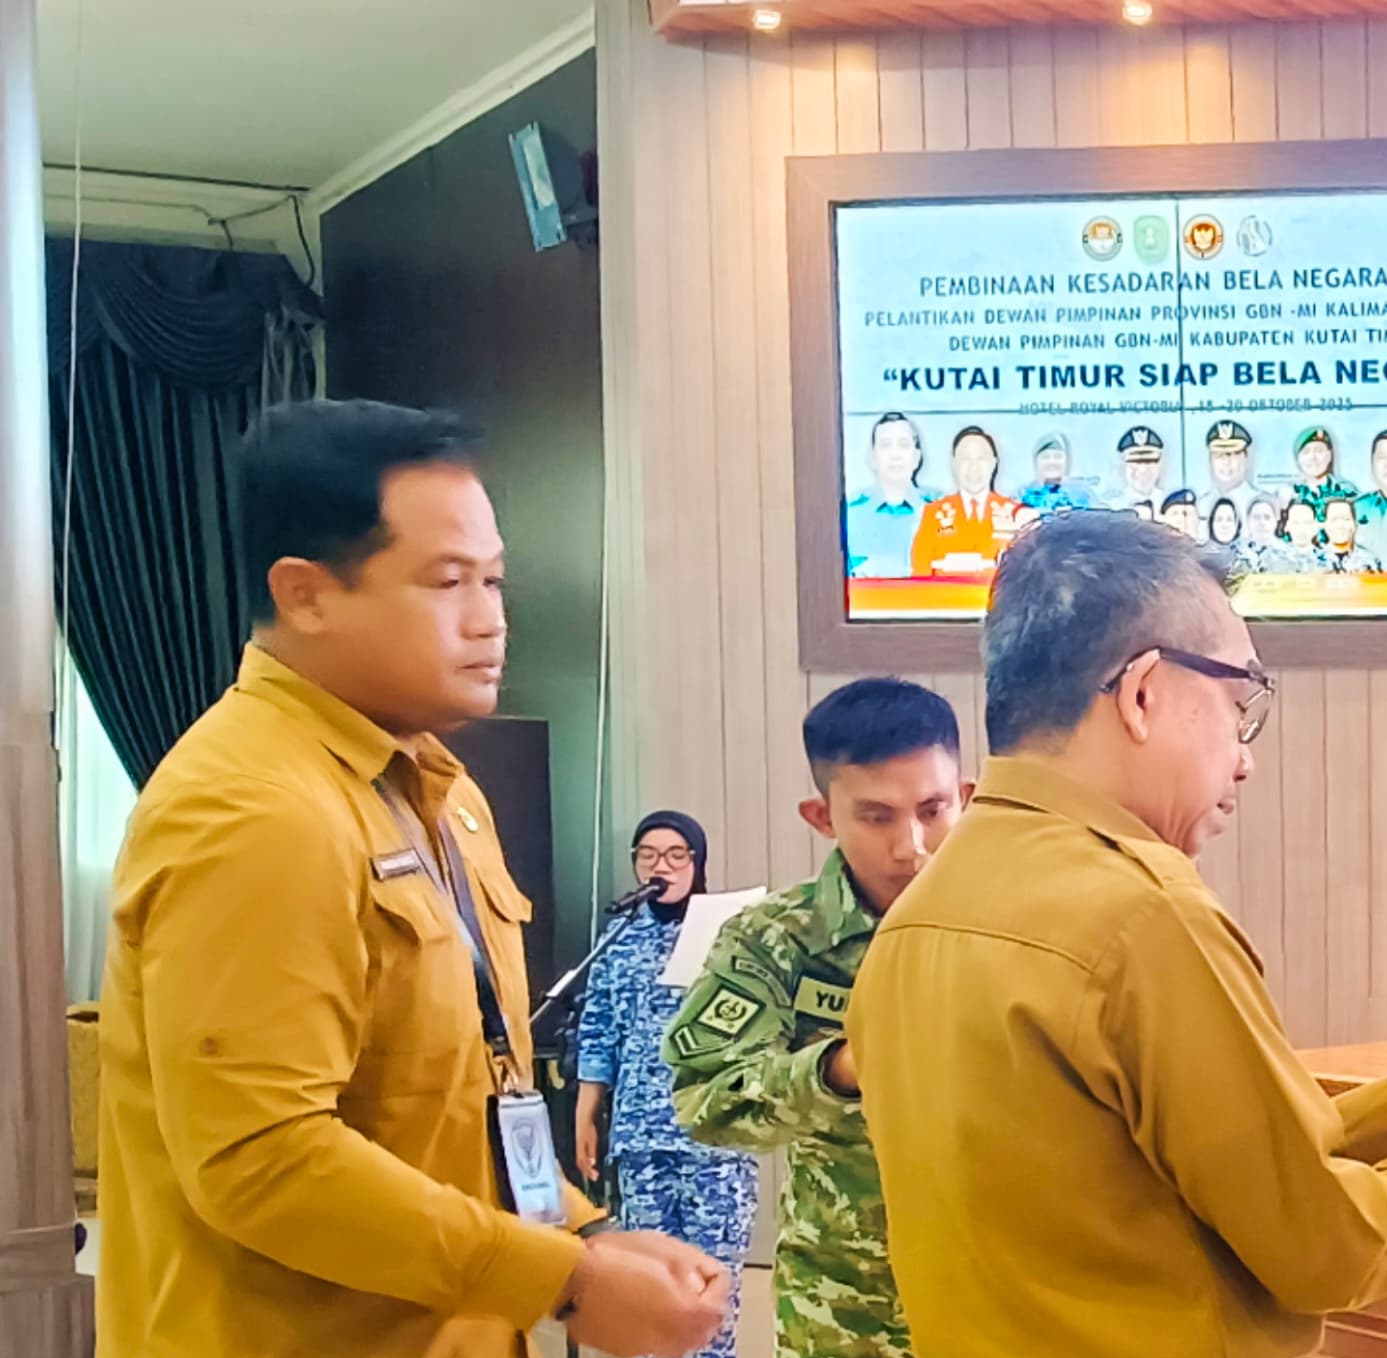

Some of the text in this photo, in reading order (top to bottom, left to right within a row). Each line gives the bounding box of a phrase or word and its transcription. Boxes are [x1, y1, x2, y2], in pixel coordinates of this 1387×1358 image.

[920, 274, 1055, 297] PEMBINAAN
[1068, 271, 1211, 294] KESADARAN
[1224, 269, 1283, 290] BELA
[865, 309, 975, 327] PELANTIKAN
[985, 308, 1047, 325] DEWAN
[1056, 306, 1141, 323] PIMPINAN
[1151, 303, 1236, 321] PROVINSI
[1246, 302, 1282, 319] GBN
[949, 334, 1010, 351] DEWAN
[1020, 333, 1105, 350] PIMPINAN
[1190, 330, 1294, 346] KABUPATEN
[1305, 329, 1357, 345] KUTAI
[1016, 364, 1125, 389] TIMUR
[1139, 362, 1218, 387] SIAP
[1233, 360, 1322, 385] BELA
[816, 990, 849, 1013] YU
